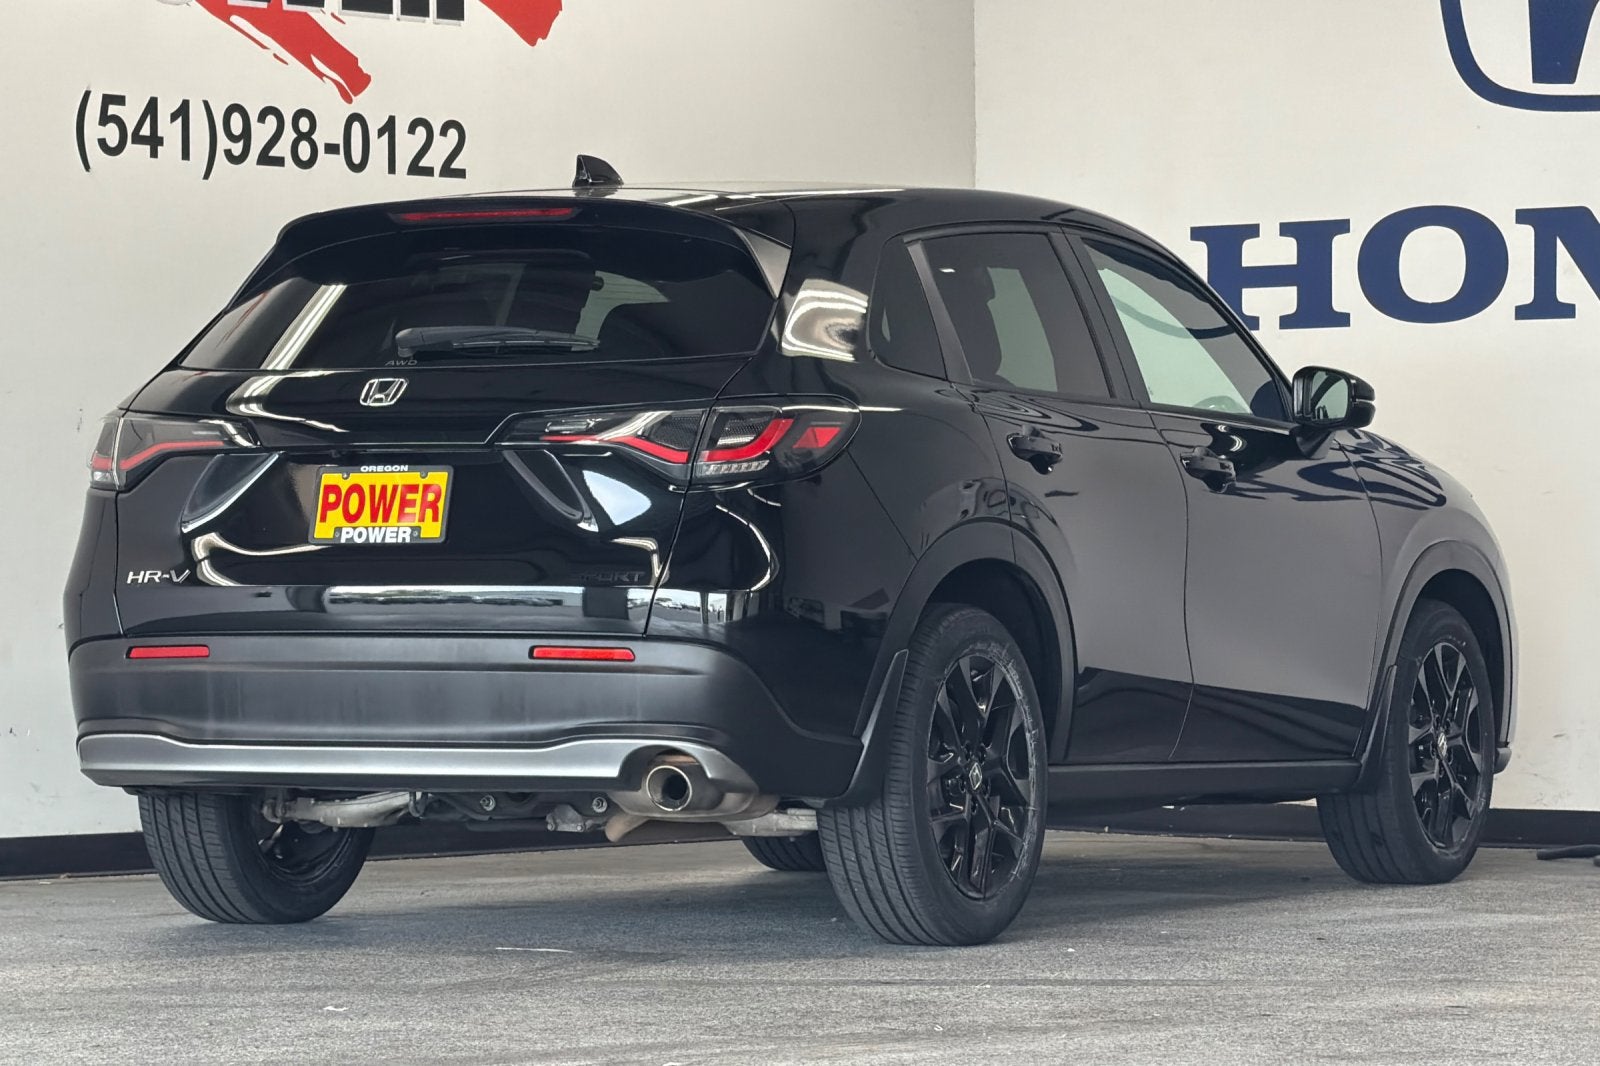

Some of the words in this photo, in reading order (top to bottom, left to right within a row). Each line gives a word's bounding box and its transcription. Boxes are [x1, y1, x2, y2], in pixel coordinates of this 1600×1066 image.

[76, 89, 467, 179] (541)928-0122
[385, 359, 418, 367] AWD
[360, 465, 408, 473] OREGON
[319, 483, 442, 524] POWER
[340, 526, 412, 544] POWER
[126, 569, 191, 584] HR-V
